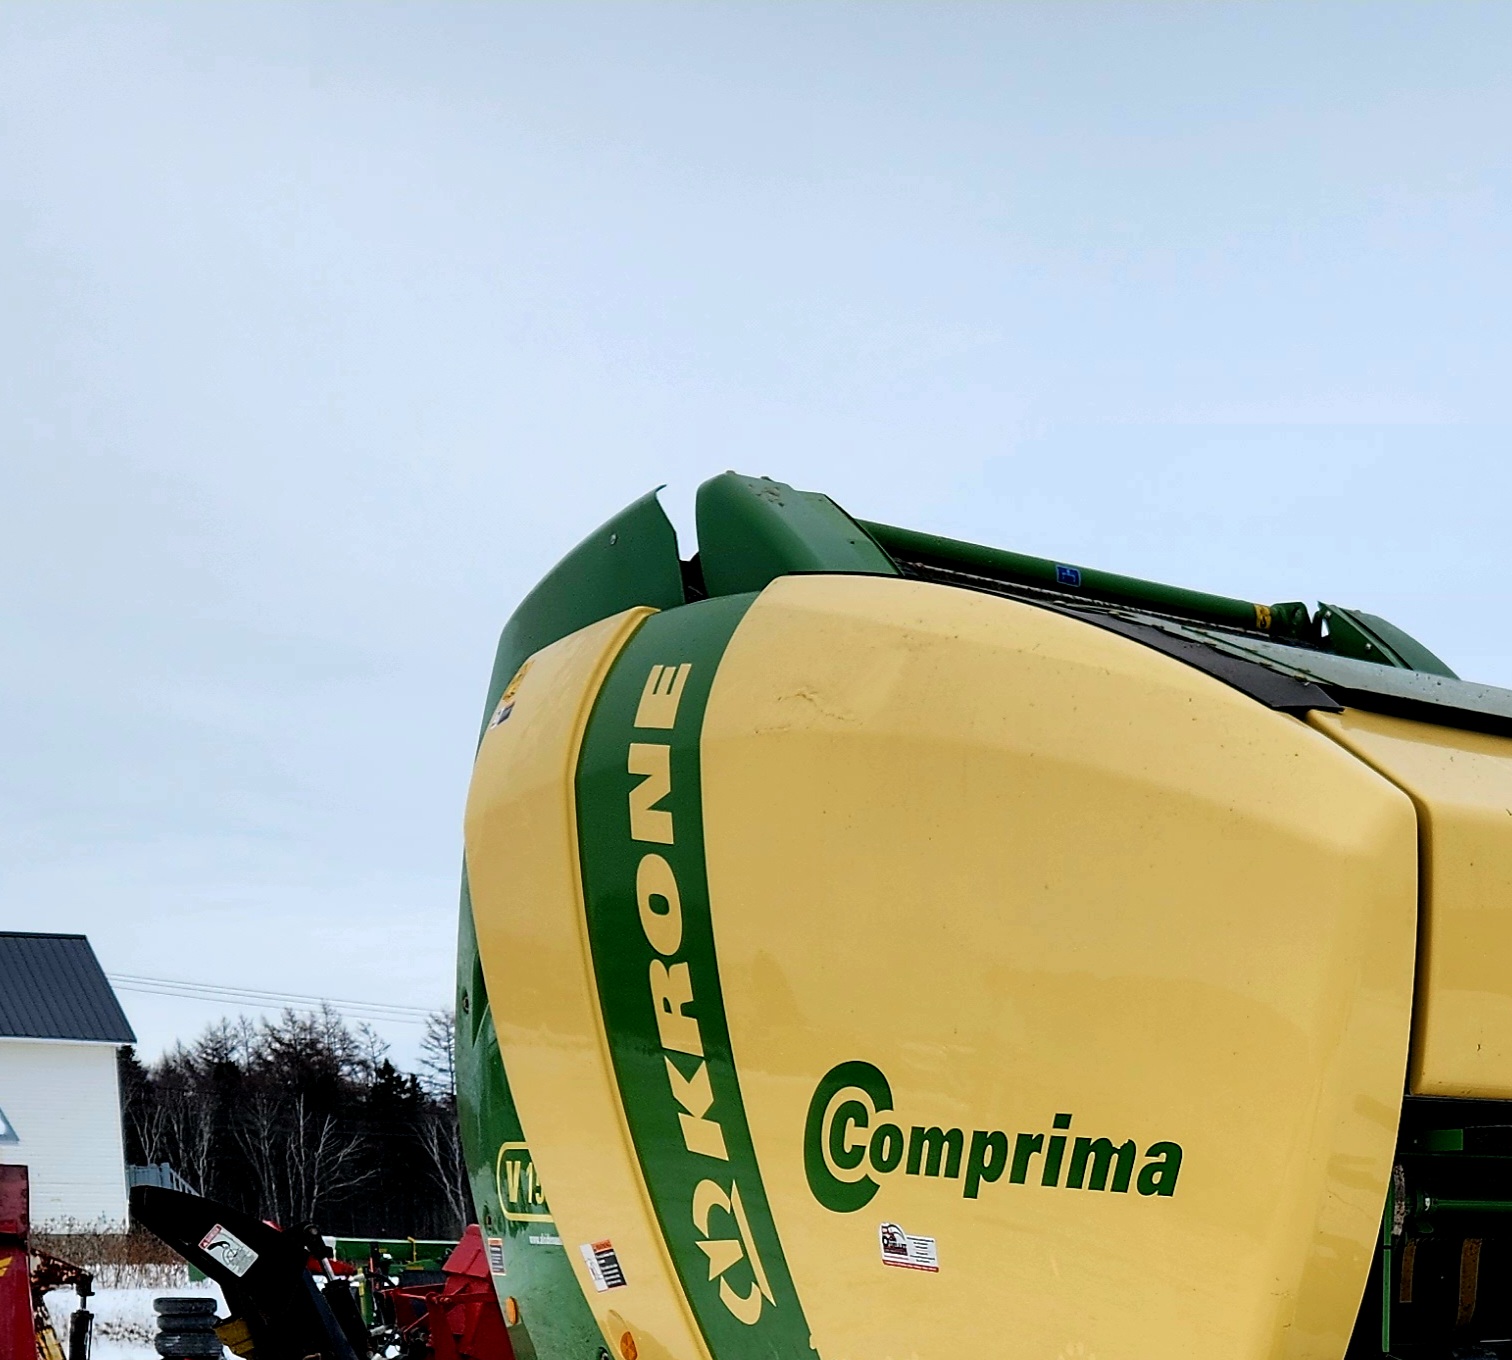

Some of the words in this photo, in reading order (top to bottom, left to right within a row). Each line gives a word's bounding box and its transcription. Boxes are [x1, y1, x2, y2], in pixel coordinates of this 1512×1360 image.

[628, 662, 729, 1162] KRONE
[505, 1160, 521, 1203] V
[804, 1060, 1183, 1213] Comprima
